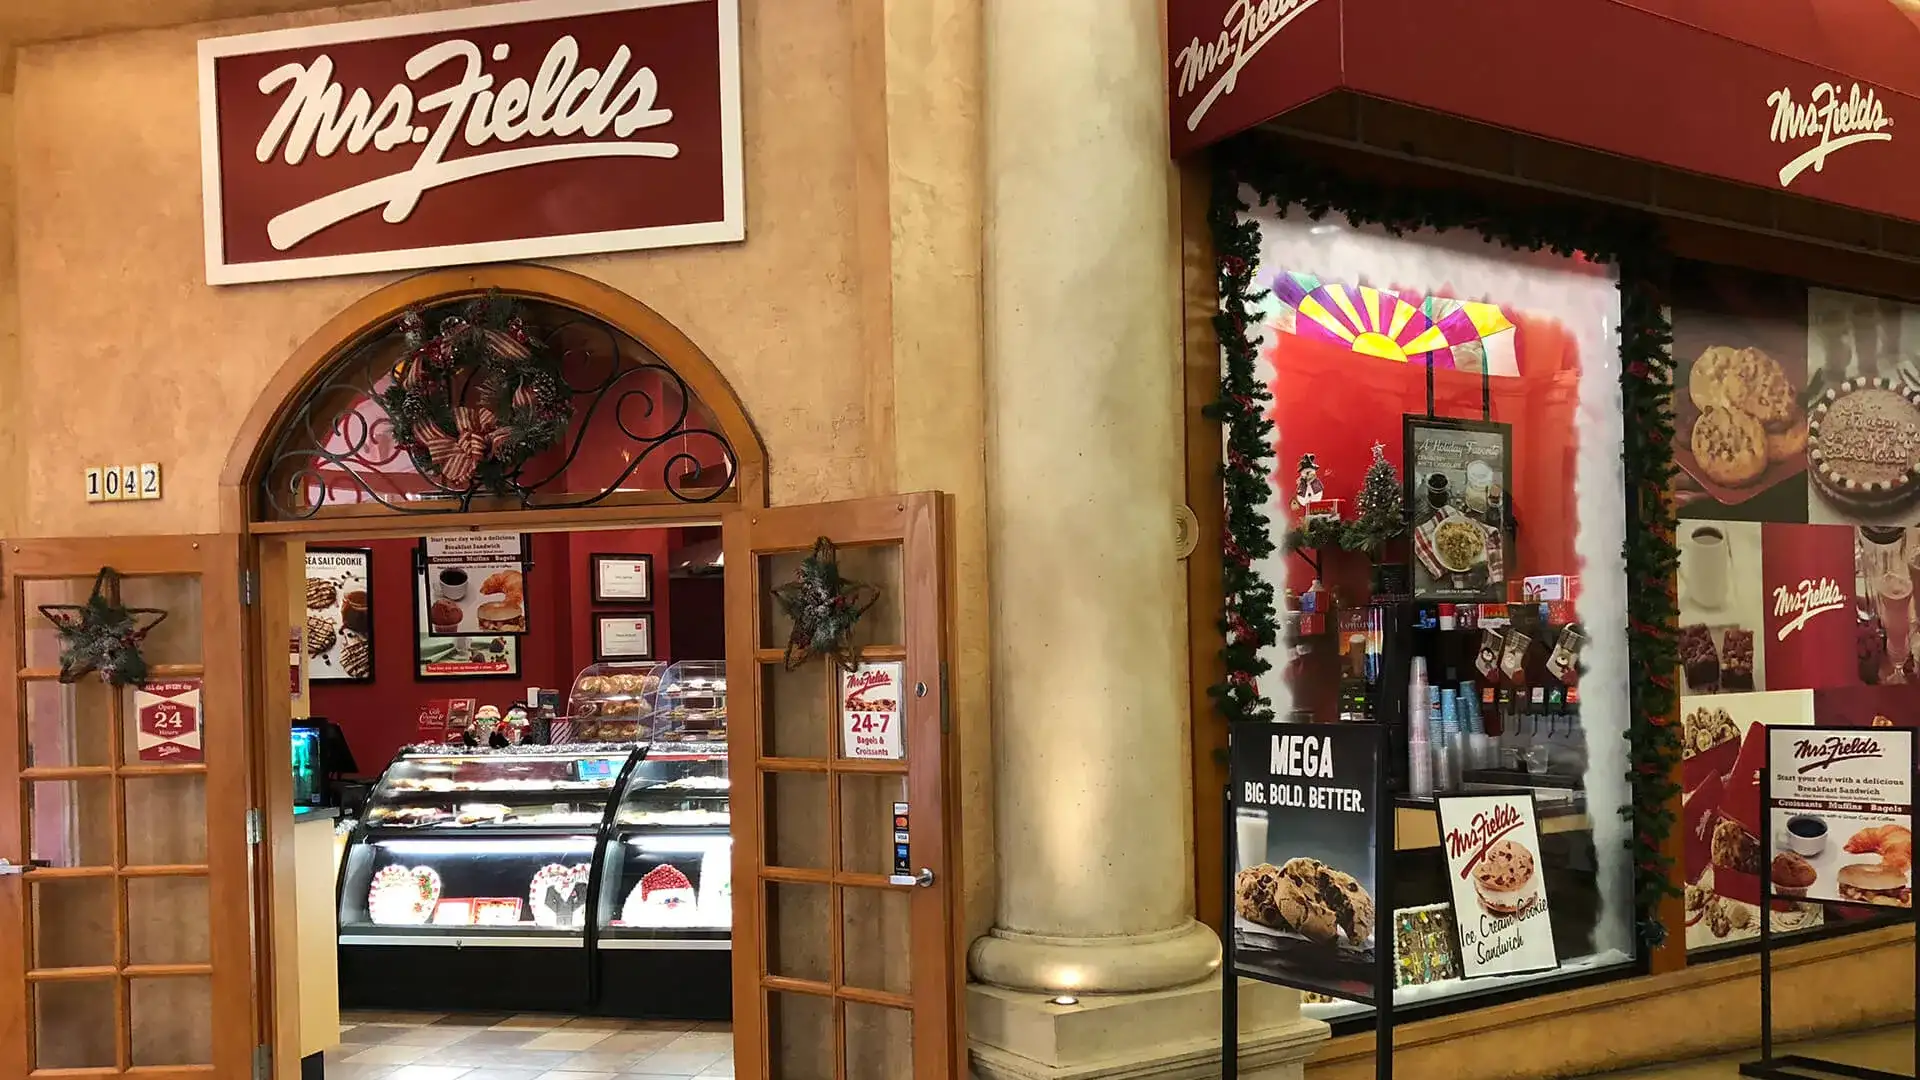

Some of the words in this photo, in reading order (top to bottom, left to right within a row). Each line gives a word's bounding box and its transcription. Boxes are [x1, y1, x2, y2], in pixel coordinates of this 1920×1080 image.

[1175, 37, 1237, 97] Mrs.
[254, 54, 430, 165] Mrs.
[383, 35, 673, 223] Fields
[1766, 87, 1823, 143] Mrs.
[1812, 82, 1888, 172] Fields
[88, 469, 156, 494] 1042
[318, 557, 335, 565] SALT
[336, 557, 362, 566] COOKIE
[1773, 585, 1804, 616] Mrs.
[1797, 577, 1843, 630] Fields
[847, 674, 865, 688] Mrs.
[861, 670, 892, 695] Fields
[155, 712, 183, 728] 24
[851, 714, 890, 733] 24-7
[856, 747, 888, 756] Croissants
[857, 736, 878, 745] Bagels
[879, 736, 885, 744] &
[1794, 740, 1830, 759] Mrs.
[1822, 736, 1881, 769] Fields
[1270, 735, 1334, 778] MEGA
[1797, 775, 1816, 783] your
[1818, 775, 1833, 783] day
[1835, 776, 1854, 784] with
[1863, 778, 1904, 786] delicious
[1798, 785, 1837, 793] Breakfast
[1839, 787, 1880, 795] Sandwich
[1244, 781, 1267, 804] BIG.
[1269, 783, 1306, 808] BOLD.
[1308, 786, 1365, 813] BETTER.
[1778, 800, 1822, 808] Croissants
[1829, 802, 1862, 810] Muffins
[1871, 804, 1902, 812] Bagels
[1446, 827, 1482, 859] Mrs.
[1471, 803, 1521, 862] Fields
[1460, 924, 1477, 947] Ice
[1479, 914, 1514, 938] Cream
[1516, 892, 1548, 922] Cookie
[1476, 927, 1524, 965] Sandwich
